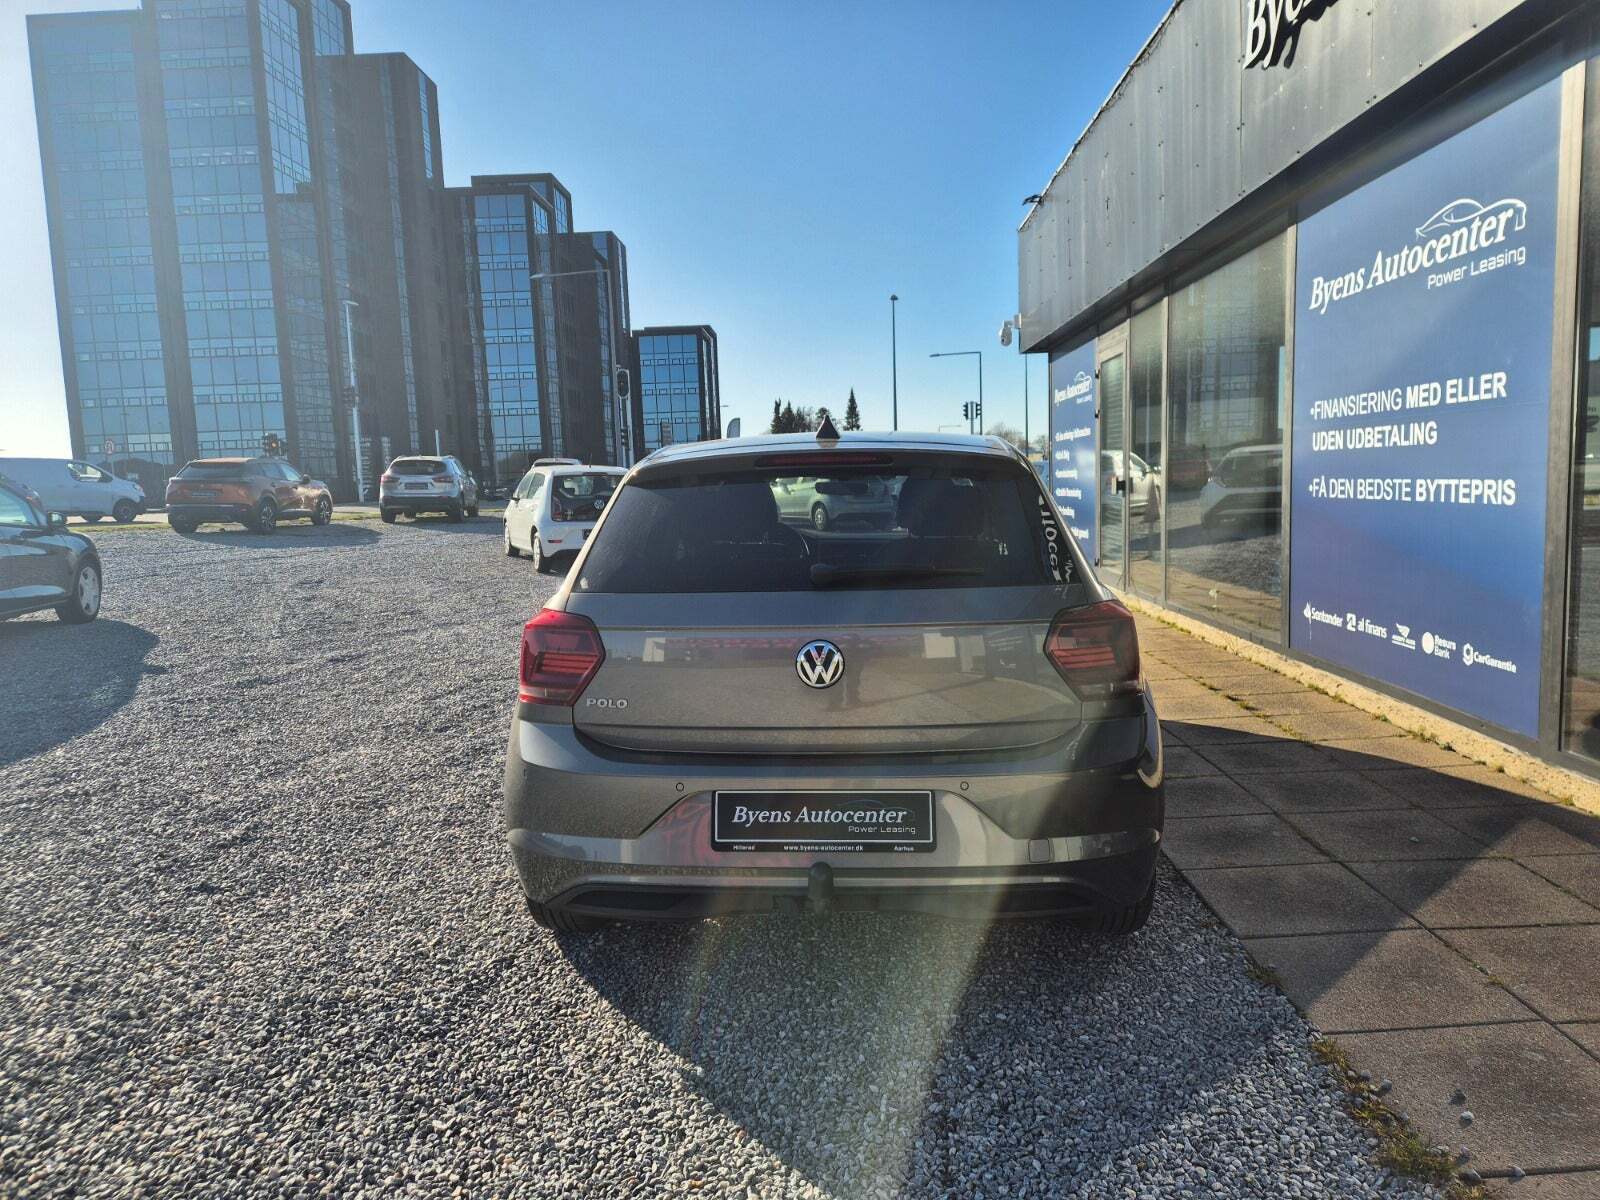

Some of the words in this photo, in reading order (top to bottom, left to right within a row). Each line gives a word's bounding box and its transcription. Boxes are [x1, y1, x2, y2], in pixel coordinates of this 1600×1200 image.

[1308, 267, 1365, 315] Byens
[1366, 208, 1514, 289] Autocenter
[1427, 265, 1467, 289] Power
[1470, 246, 1526, 276] Leasing
[1313, 388, 1403, 420] FINANSIERING
[1405, 381, 1442, 409] MED
[1445, 371, 1508, 404] ELLER
[1312, 429, 1344, 451] UDEN
[1346, 421, 1438, 449] UDBETALING
[1312, 475, 1328, 498] FÅ
[1329, 478, 1354, 498] DEN
[1356, 478, 1412, 501] BEDSTE
[1415, 479, 1517, 506] BYTTEPRIS
[586, 698, 628, 709] POLO
[731, 805, 792, 828] Byens
[794, 805, 907, 823] Autocenter
[848, 825, 878, 833] Power
[880, 825, 916, 834] Leasing
